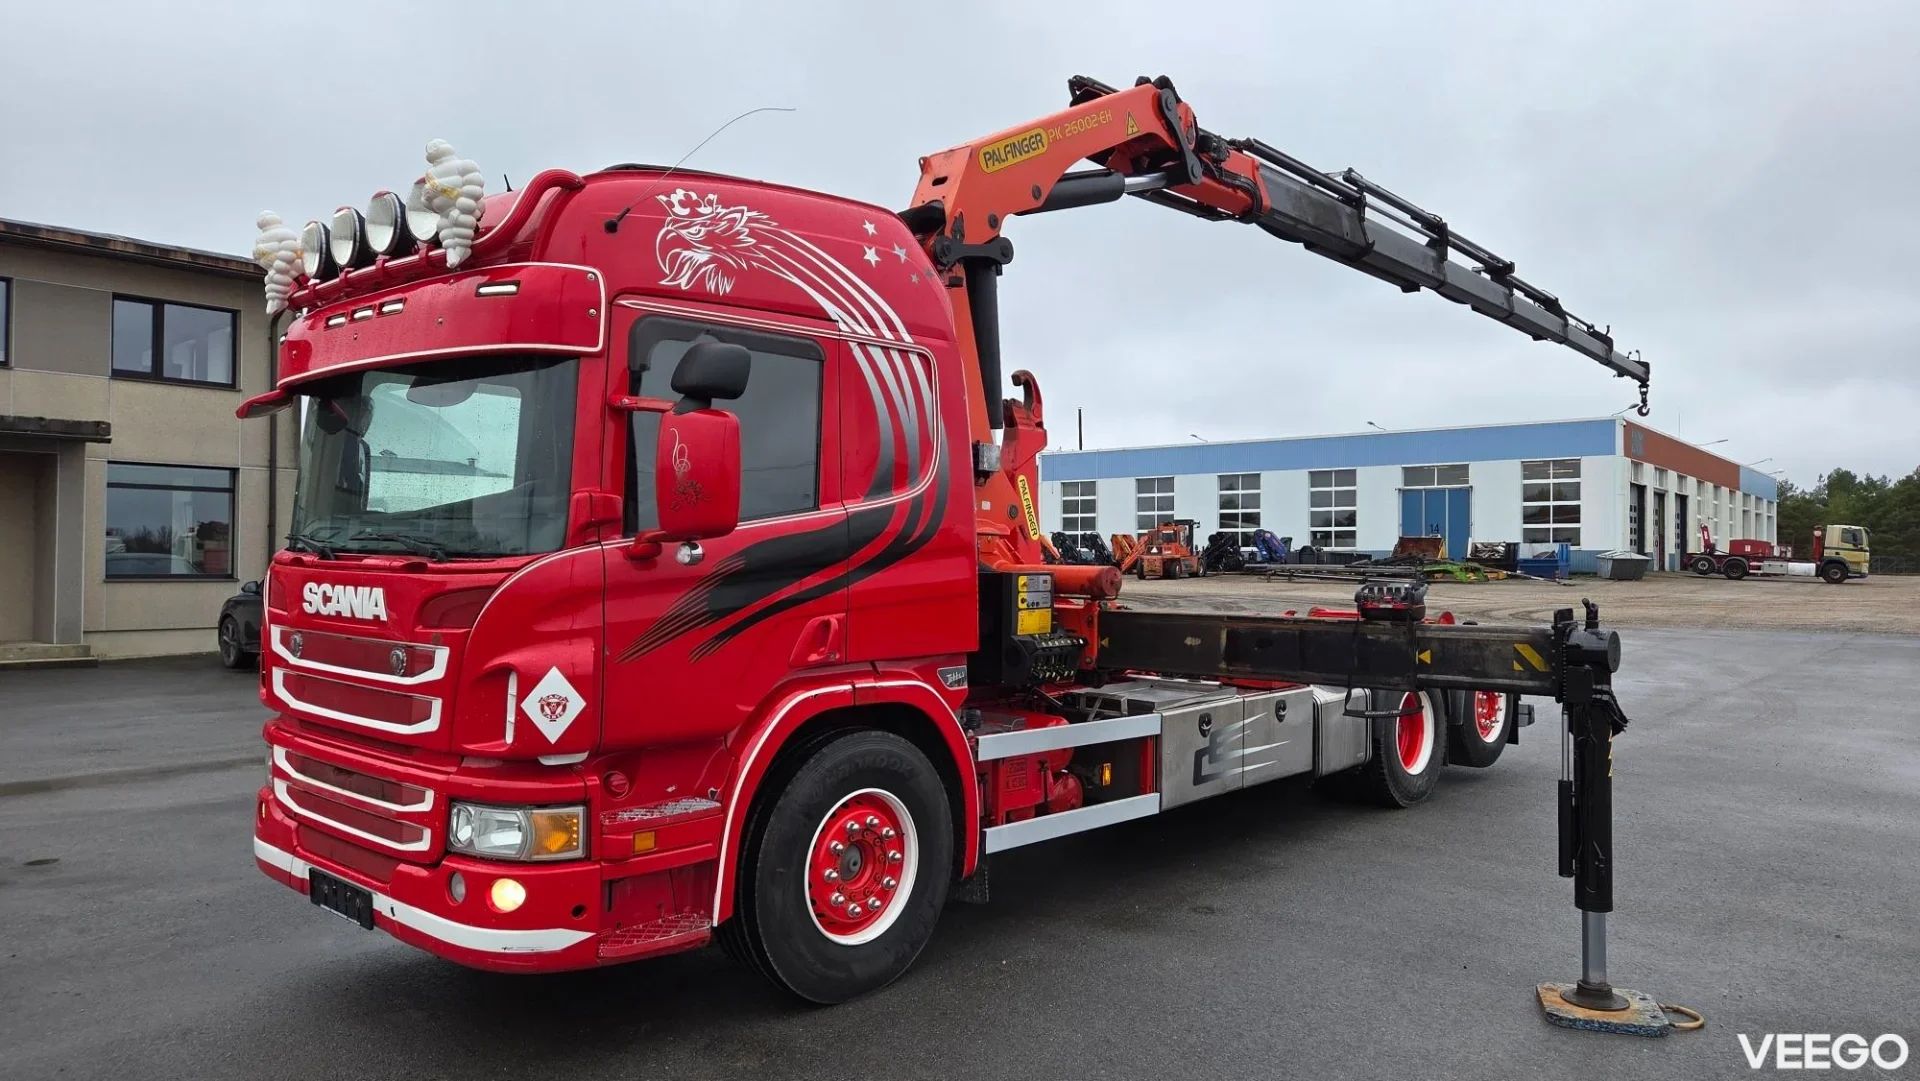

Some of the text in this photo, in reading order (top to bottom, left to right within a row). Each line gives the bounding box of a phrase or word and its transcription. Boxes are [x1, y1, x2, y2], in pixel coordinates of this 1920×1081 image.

[982, 109, 1114, 169] PALFINGER PK 26002-EH
[1019, 478, 1038, 537] PALFINGER
[302, 581, 388, 622] SCANIA
